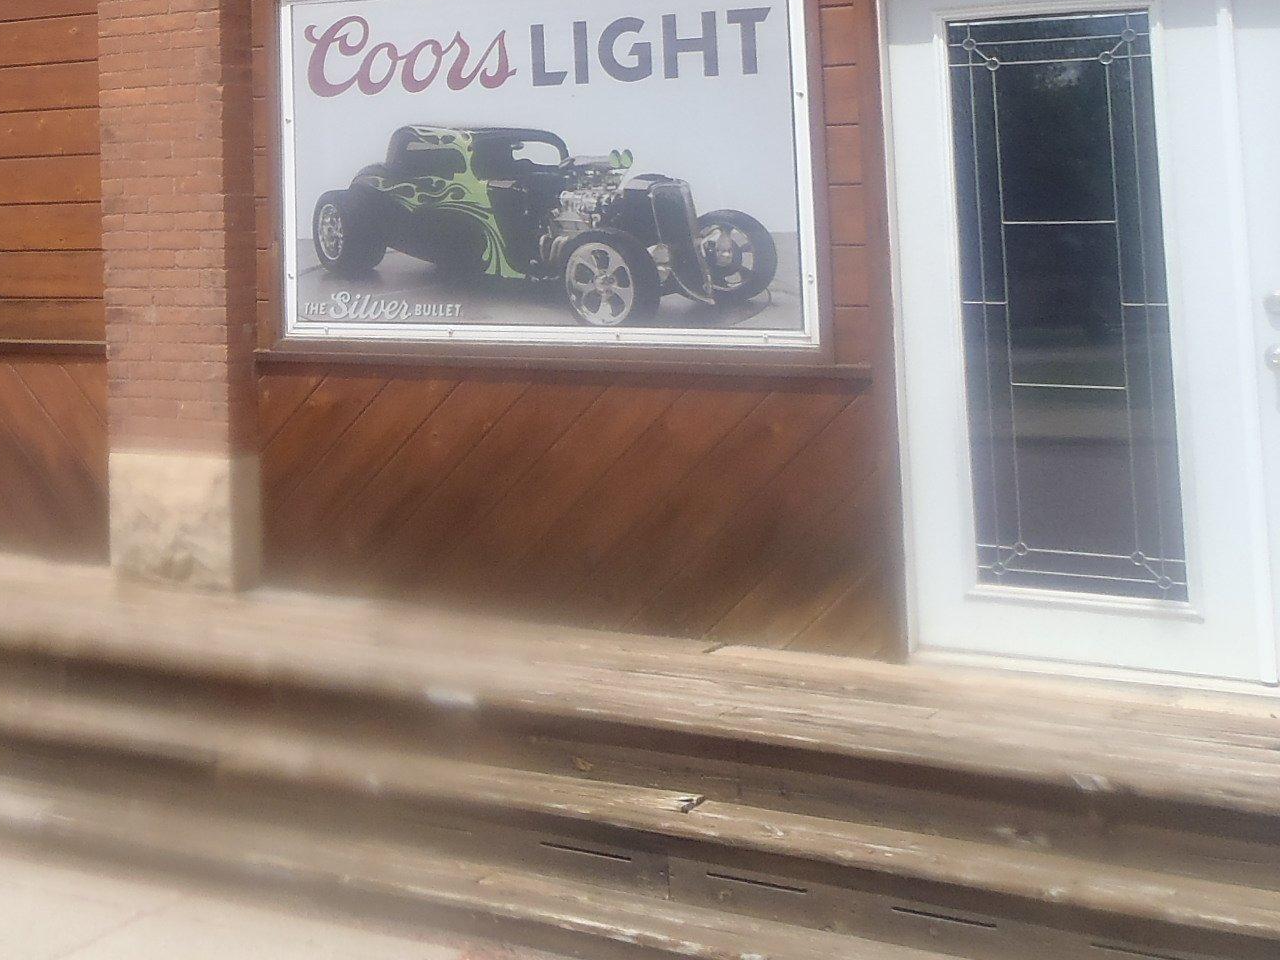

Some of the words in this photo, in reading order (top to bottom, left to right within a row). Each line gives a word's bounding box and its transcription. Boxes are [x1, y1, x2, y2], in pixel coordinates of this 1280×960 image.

[304, 14, 517, 98] Coors
[529, 6, 772, 87] LIGHT
[305, 302, 327, 316] THE
[329, 291, 413, 321] Silver
[414, 303, 462, 318] BULLET
